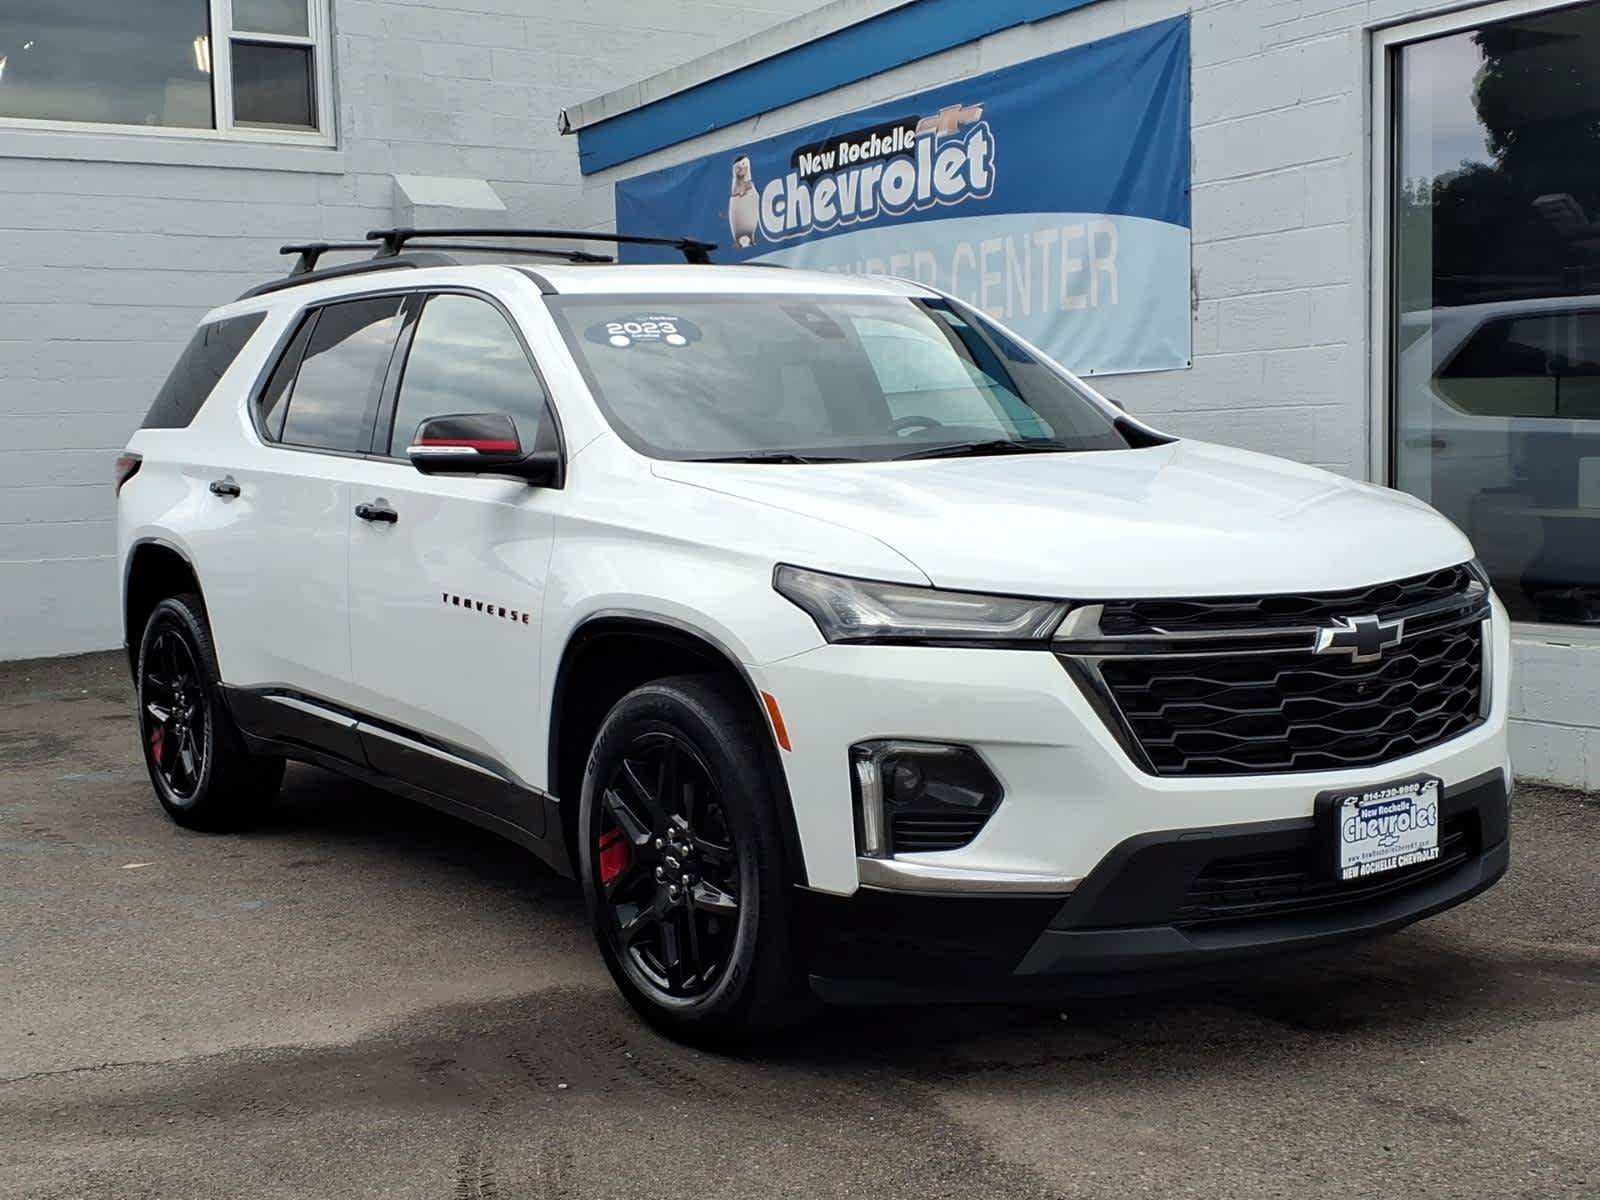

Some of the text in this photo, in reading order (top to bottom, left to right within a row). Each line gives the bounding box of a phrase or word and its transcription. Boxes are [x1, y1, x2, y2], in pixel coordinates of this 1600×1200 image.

[799, 126, 915, 177] New Rochelle
[761, 129, 988, 234] Chevrolet
[951, 219, 1119, 319] CENTER
[606, 321, 678, 335] 2023
[442, 592, 529, 625] TRAVERSE
[1343, 802, 1436, 843] Chevrolet
[1361, 800, 1411, 819] New Rochelle
[1343, 865, 1360, 880] NEW
[1360, 855, 1398, 876] ROCHELLE
[1398, 847, 1440, 867] CHEVROLET
